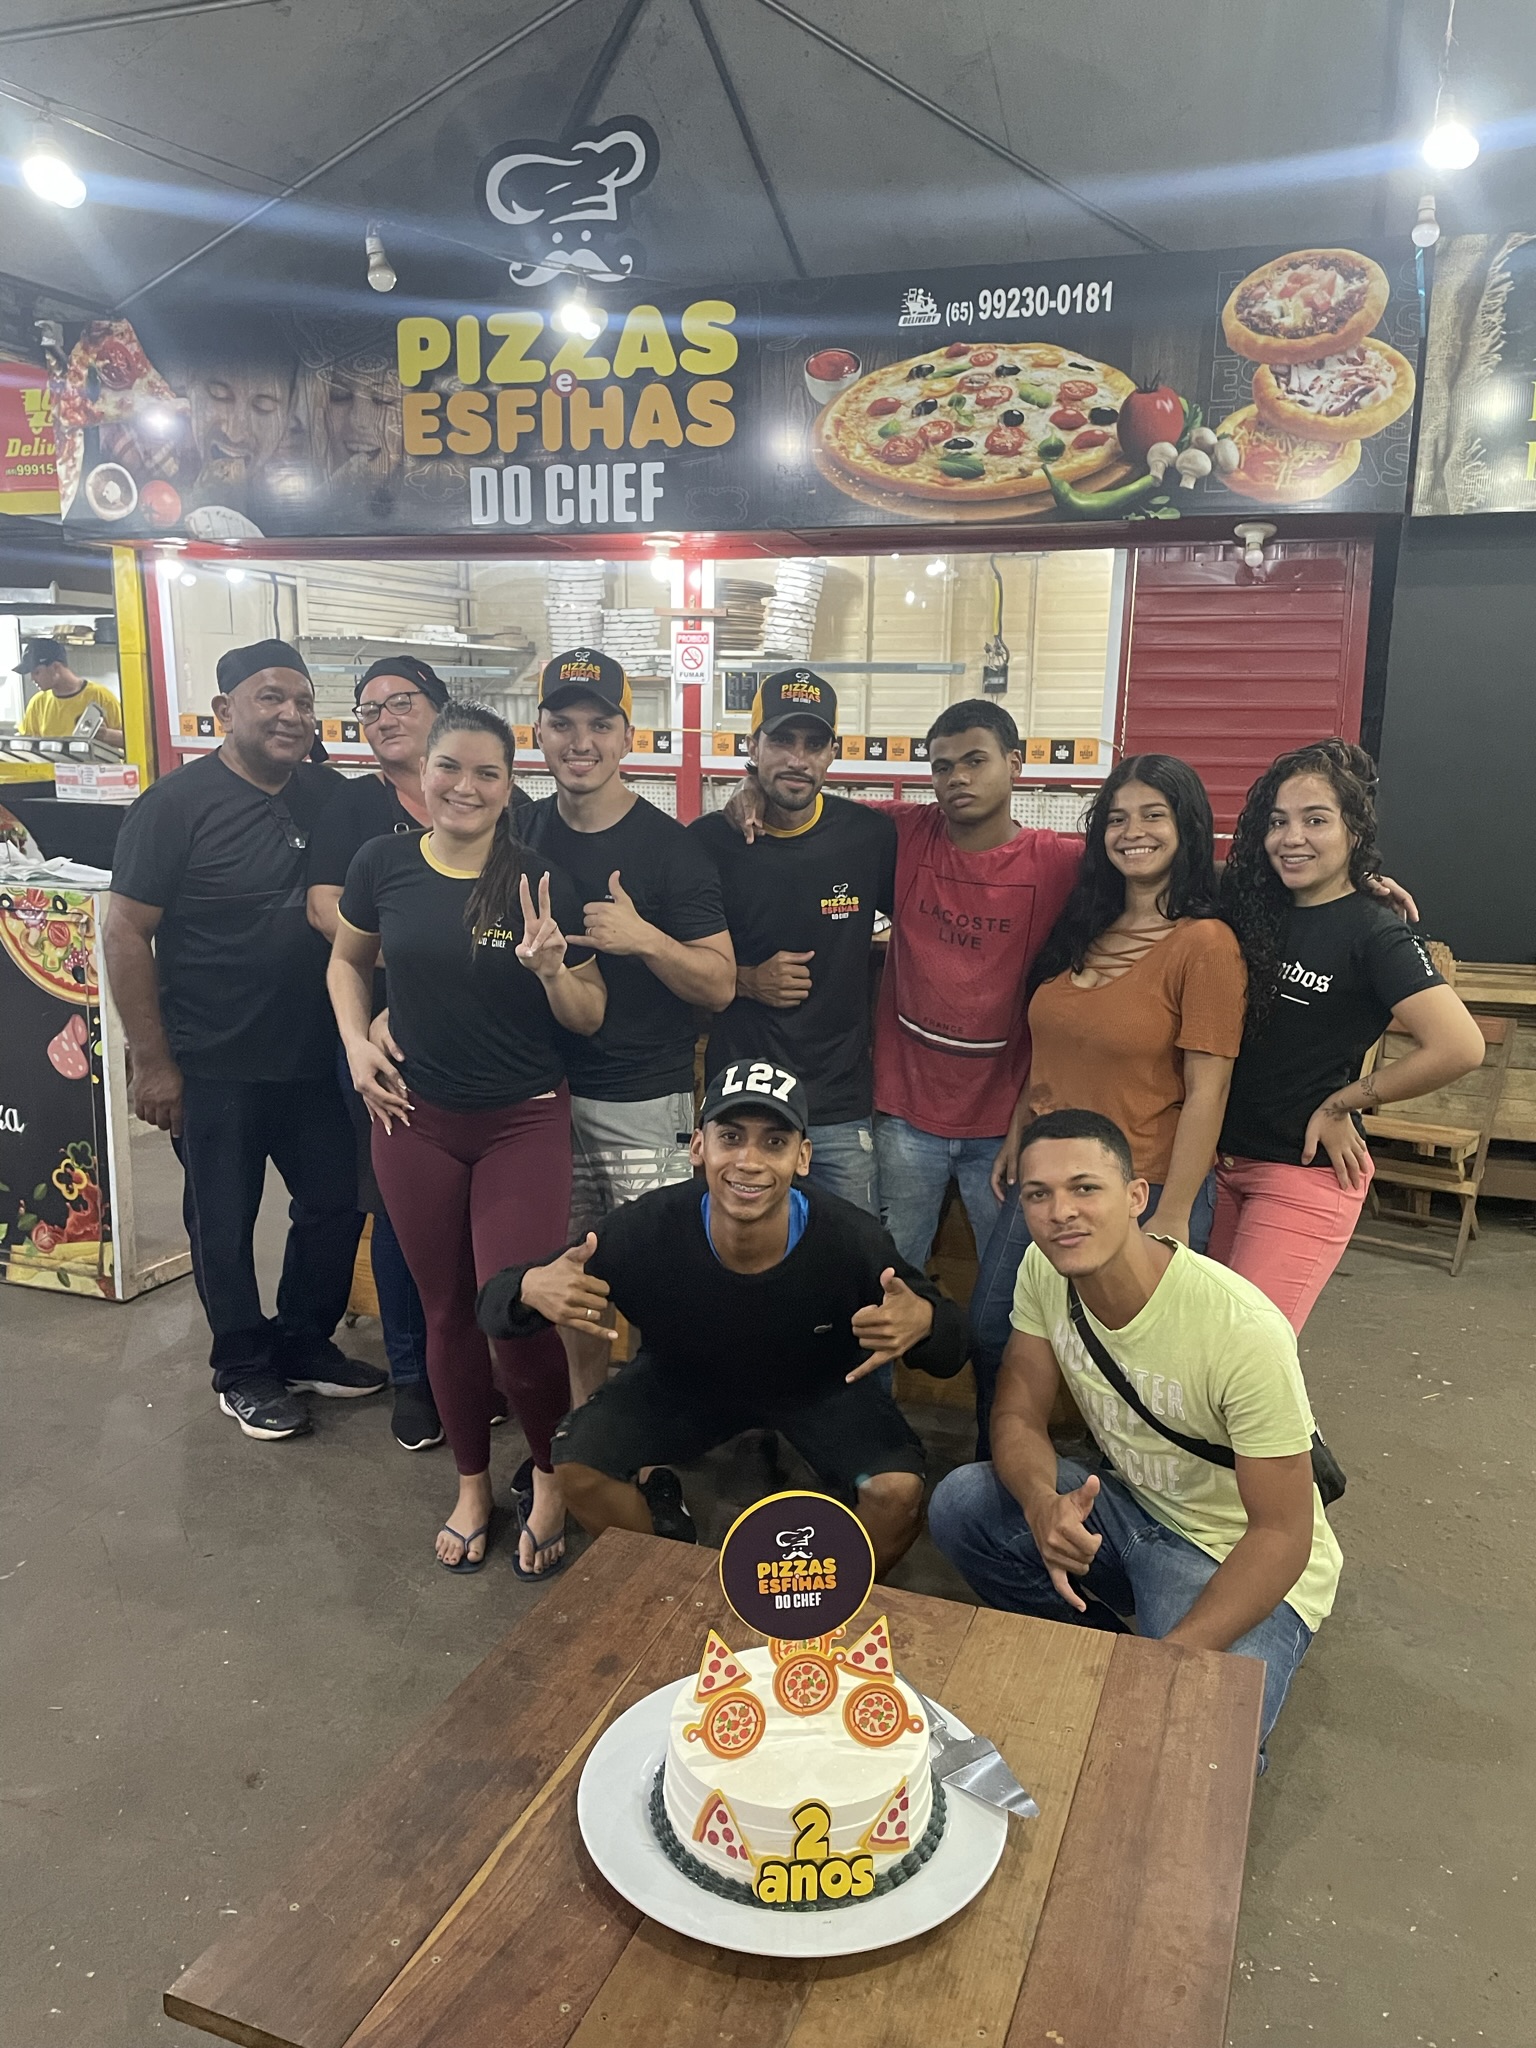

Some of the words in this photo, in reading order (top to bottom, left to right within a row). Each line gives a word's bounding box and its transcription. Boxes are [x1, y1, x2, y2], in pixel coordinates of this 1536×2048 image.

[945, 301, 974, 327] (65)
[978, 280, 1113, 321] 99230-0181
[902, 315, 937, 325] DELIVERY
[396, 299, 739, 388] PIZZAS
[555, 372, 573, 392] e
[402, 380, 737, 455] ESFIHAS
[469, 466, 533, 526] DO
[544, 461, 665, 525] CHEF
[560, 670, 601, 681] ESFIHAS
[561, 662, 601, 674] PIZZAS
[781, 691, 821, 703] ESFIHAS
[782, 683, 821, 696] PIZZAS
[820, 896, 859, 908] PIZZAS
[918, 899, 1012, 933] LACOSTE
[938, 928, 983, 950] LIVE
[923, 1016, 965, 1035] FRANCE
[721, 1062, 797, 1103] L27
[757, 1557, 837, 1580] PIZZAS
[758, 1574, 837, 1595] ESFIHAS
[775, 1594, 791, 1610] DO
[793, 1592, 822, 1608] CHEF
[792, 1802, 831, 1861] 2
[757, 1854, 875, 1904] anos
